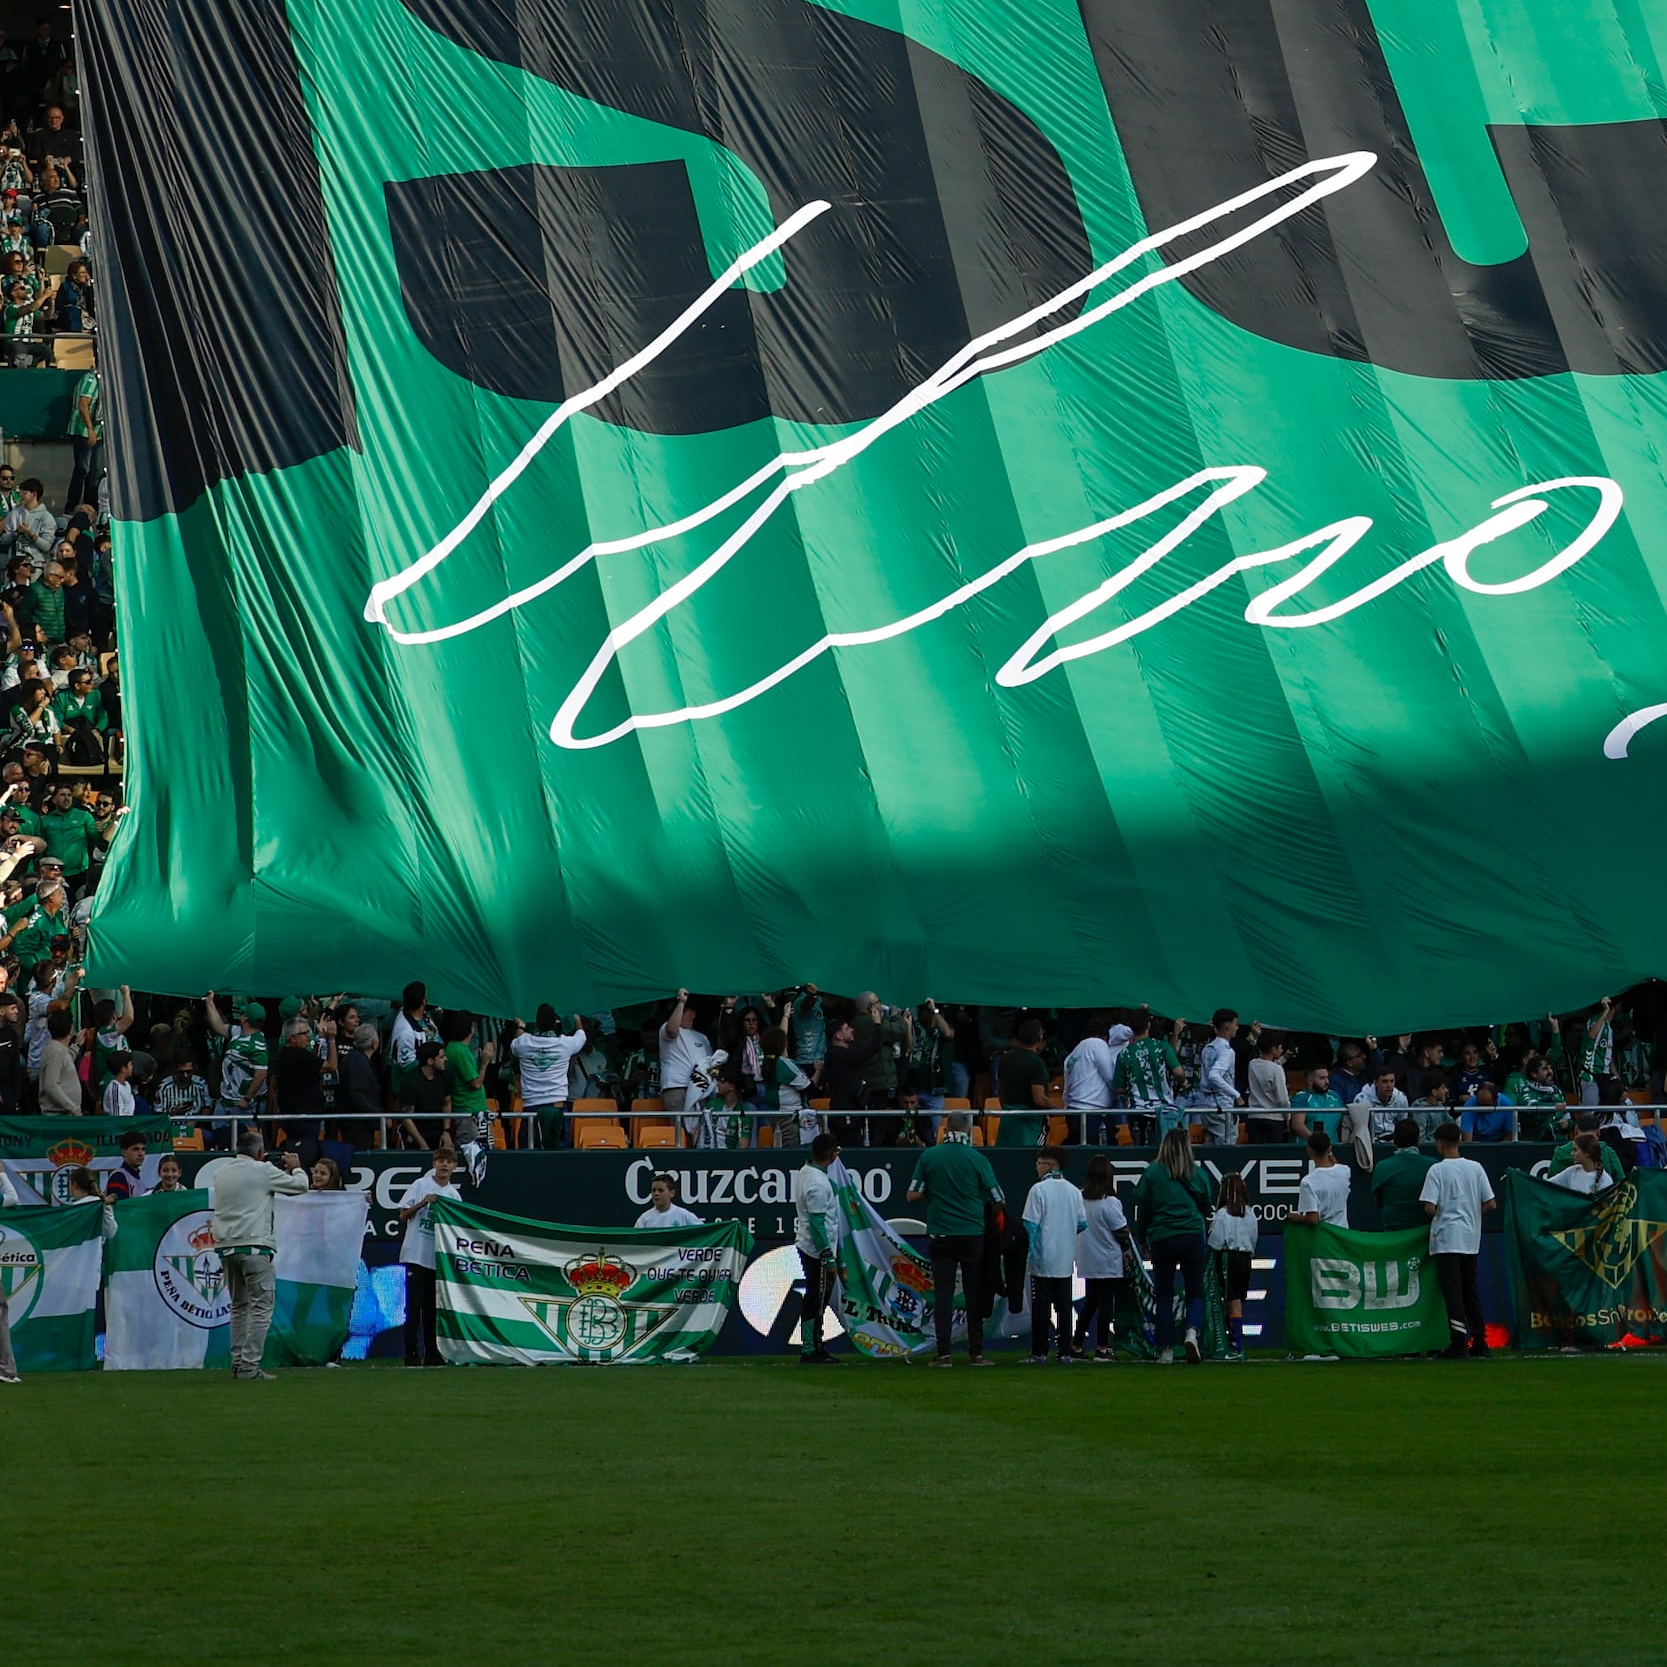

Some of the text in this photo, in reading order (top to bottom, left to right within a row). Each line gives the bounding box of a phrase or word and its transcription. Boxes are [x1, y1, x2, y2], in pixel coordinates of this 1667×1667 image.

[455, 1237, 515, 1259] PEÑA
[678, 1248, 722, 1262] VERDE
[0, 1251, 36, 1265] ética
[454, 1257, 531, 1282] BÉTICA
[647, 1267, 676, 1282] QUE
[678, 1268, 696, 1282] TE
[159, 1269, 181, 1304] PEÑA
[1309, 1256, 1422, 1311] BW
[673, 1288, 716, 1303] VERDE
[1313, 1320, 1422, 1334] www.BETISWEB.com
